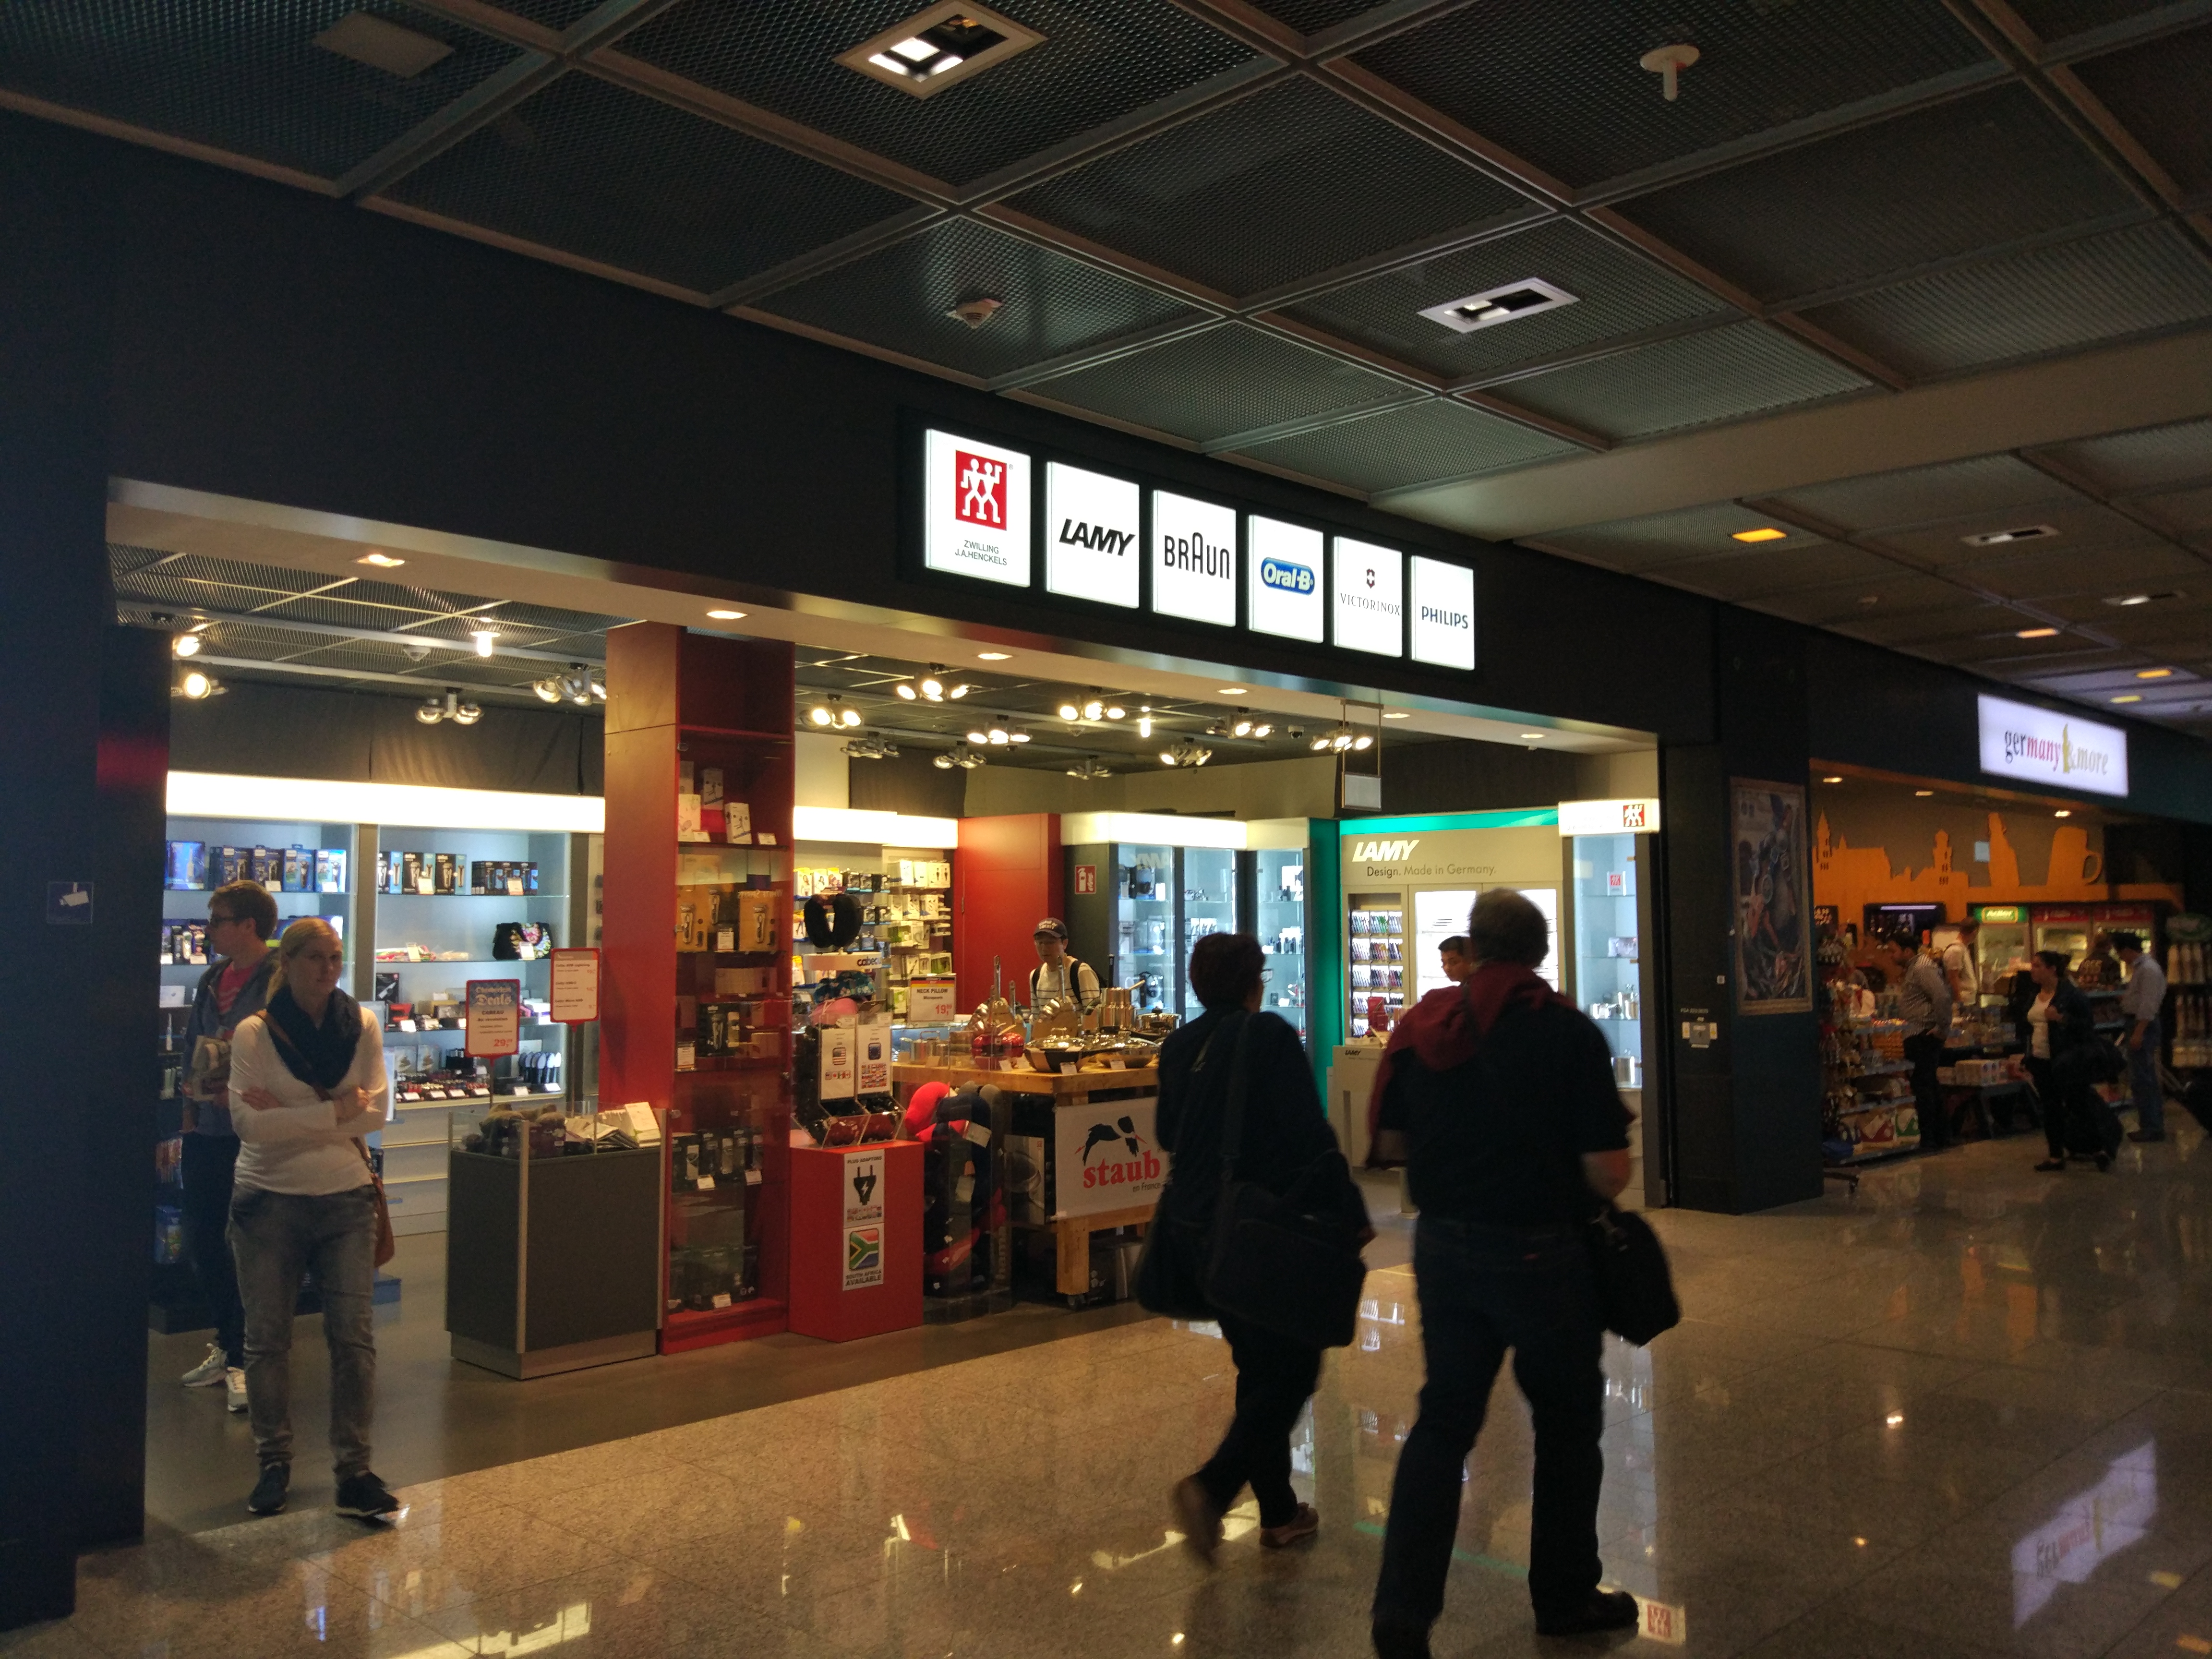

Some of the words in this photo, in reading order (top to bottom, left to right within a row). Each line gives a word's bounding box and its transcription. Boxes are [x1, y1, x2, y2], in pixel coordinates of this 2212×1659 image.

[964, 540, 999, 554] ZWILLING
[1059, 518, 1136, 556] LAMY
[1165, 532, 1230, 579] BRAUN
[1263, 563, 1311, 591] Oral-B
[1340, 593, 1400, 616] VICTORINOX
[1421, 606, 1468, 629] PHILIPS
[2004, 730, 2061, 771] germany
[1352, 839, 1420, 862] LAMY
[1367, 866, 1401, 878] Design.
[1404, 865, 1432, 875] Made
[1435, 865, 1443, 875] in
[1447, 864, 1496, 877] Germany.
[1083, 1149, 1160, 1188] staub
